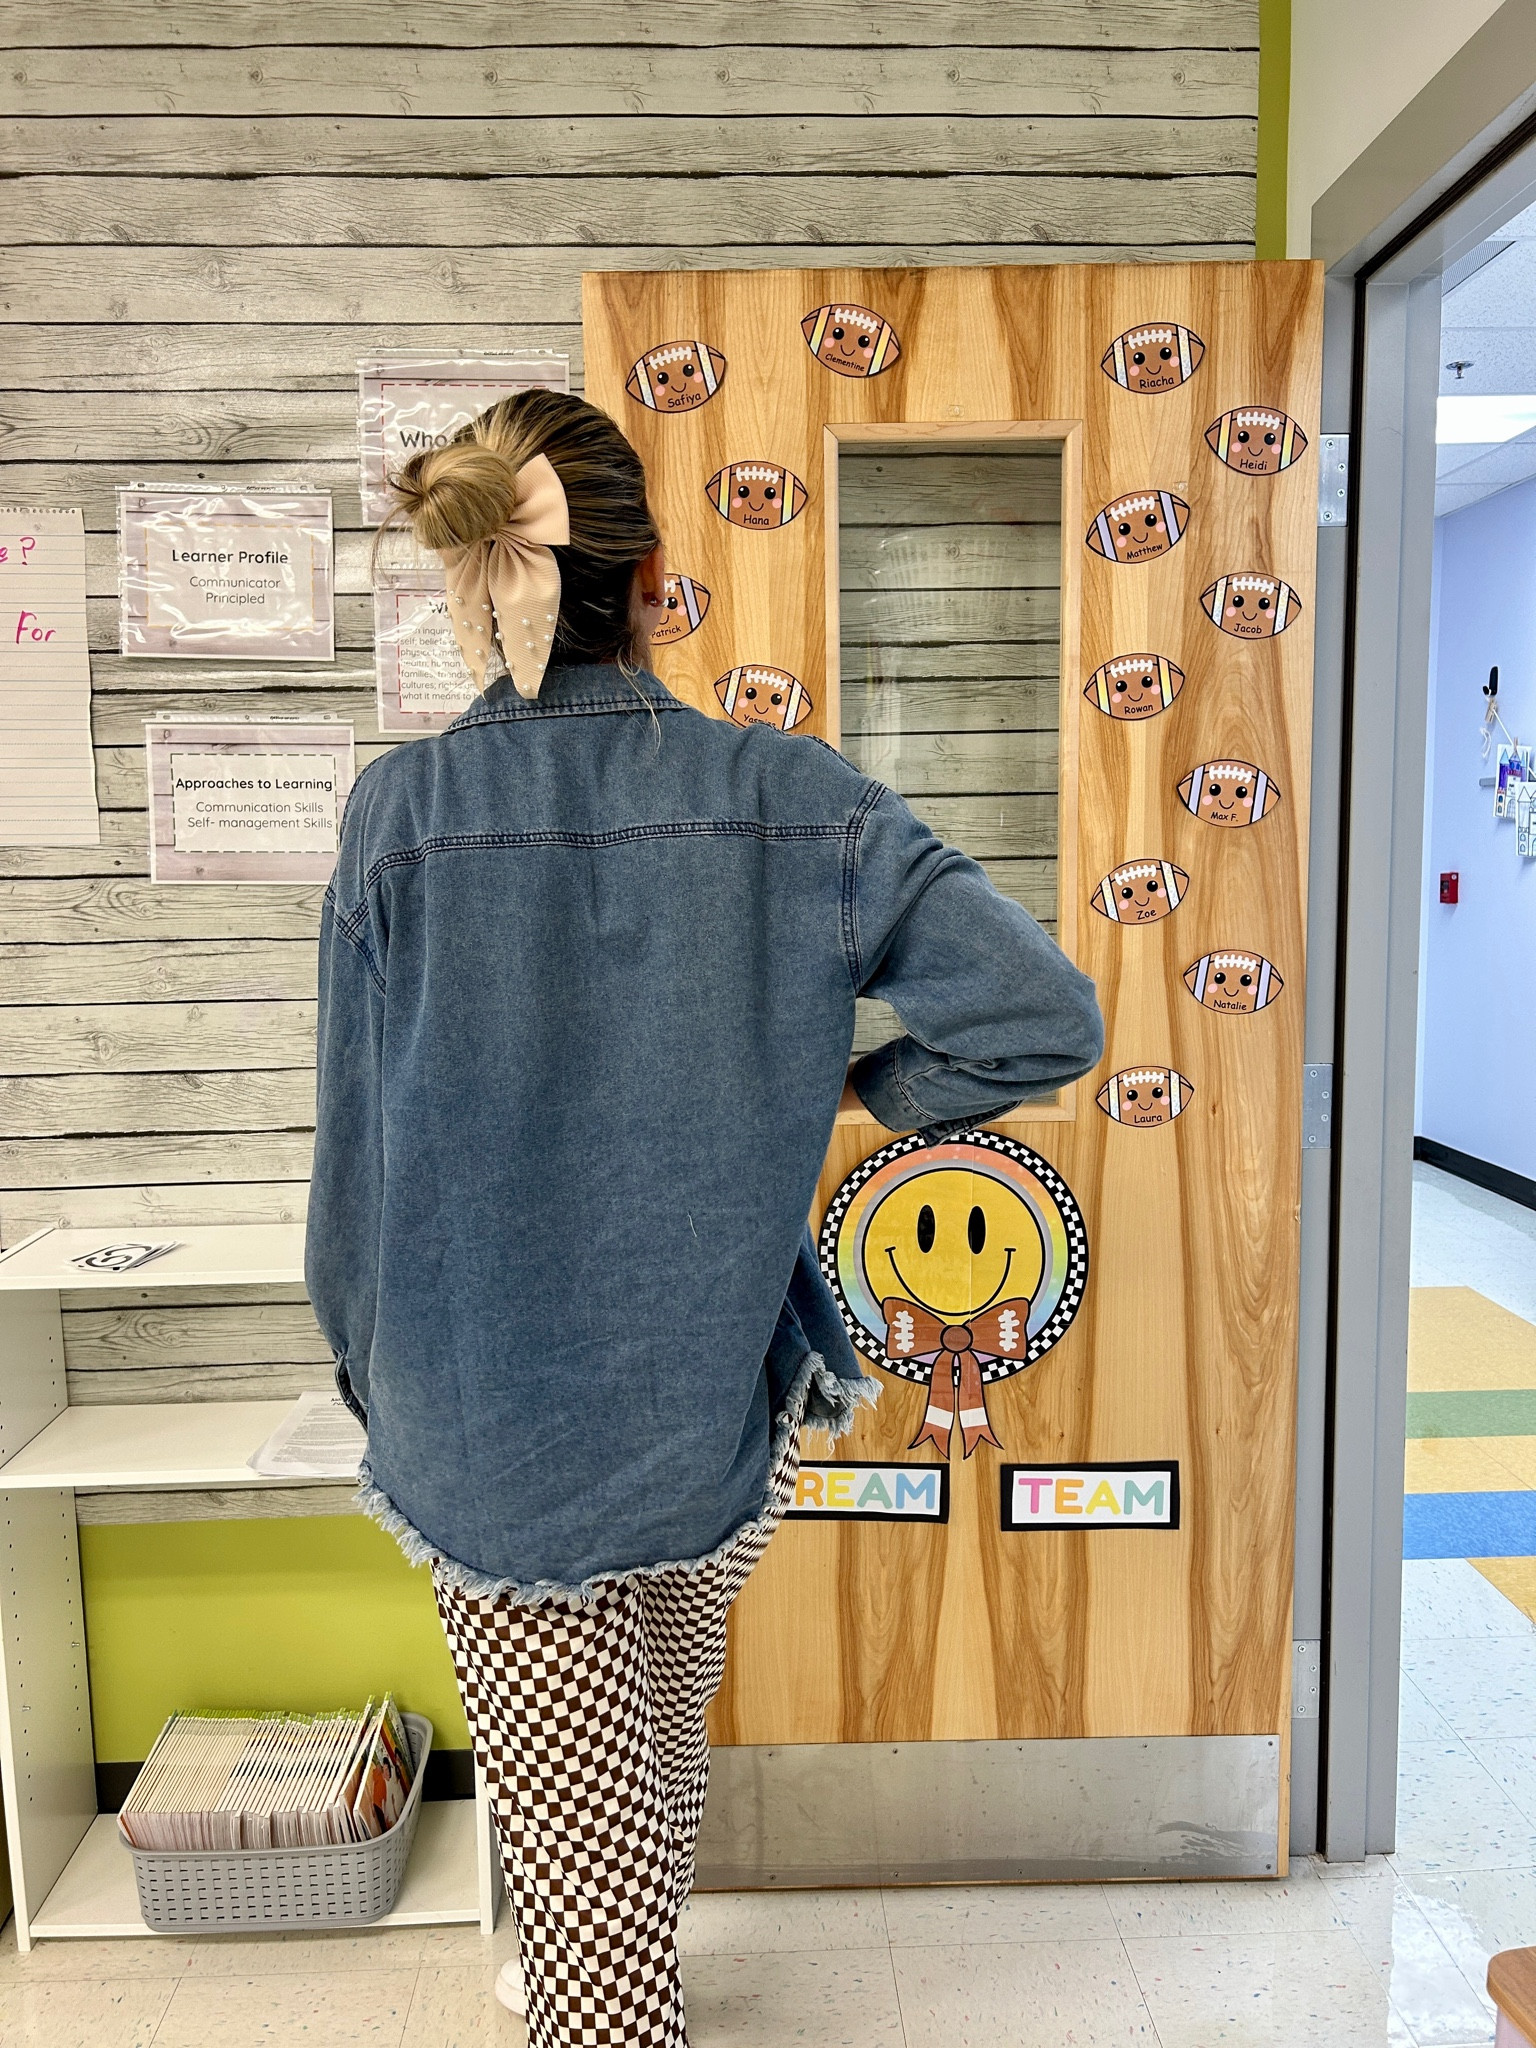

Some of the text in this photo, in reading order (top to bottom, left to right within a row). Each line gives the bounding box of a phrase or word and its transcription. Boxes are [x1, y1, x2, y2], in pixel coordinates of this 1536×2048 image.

[825, 353, 865, 372] Clementine
[1140, 376, 1175, 390] Riacha
[667, 392, 702, 408] Safiya
[400, 430, 448, 448] Who
[1239, 458, 1268, 471] Heidi
[743, 514, 770, 526] Hana
[172, 549, 288, 564] Learner Profile
[1126, 543, 1163, 560] Matthew
[189, 576, 281, 588] Communicator
[206, 592, 265, 606] Principled
[16, 610, 56, 644] For
[1233, 622, 1263, 635] Jacob
[1124, 703, 1154, 715] Rowan
[176, 778, 333, 792] Approaches to Learning
[195, 801, 324, 813] Communication Skills
[187, 816, 333, 831] Self- management Skills
[1210, 811, 1239, 822] Max F.
[1137, 909, 1157, 920] Zoe
[1213, 999, 1248, 1012] Natalie
[1134, 1113, 1163, 1125] Laura
[795, 1472, 1164, 1516] REAM TEAM
